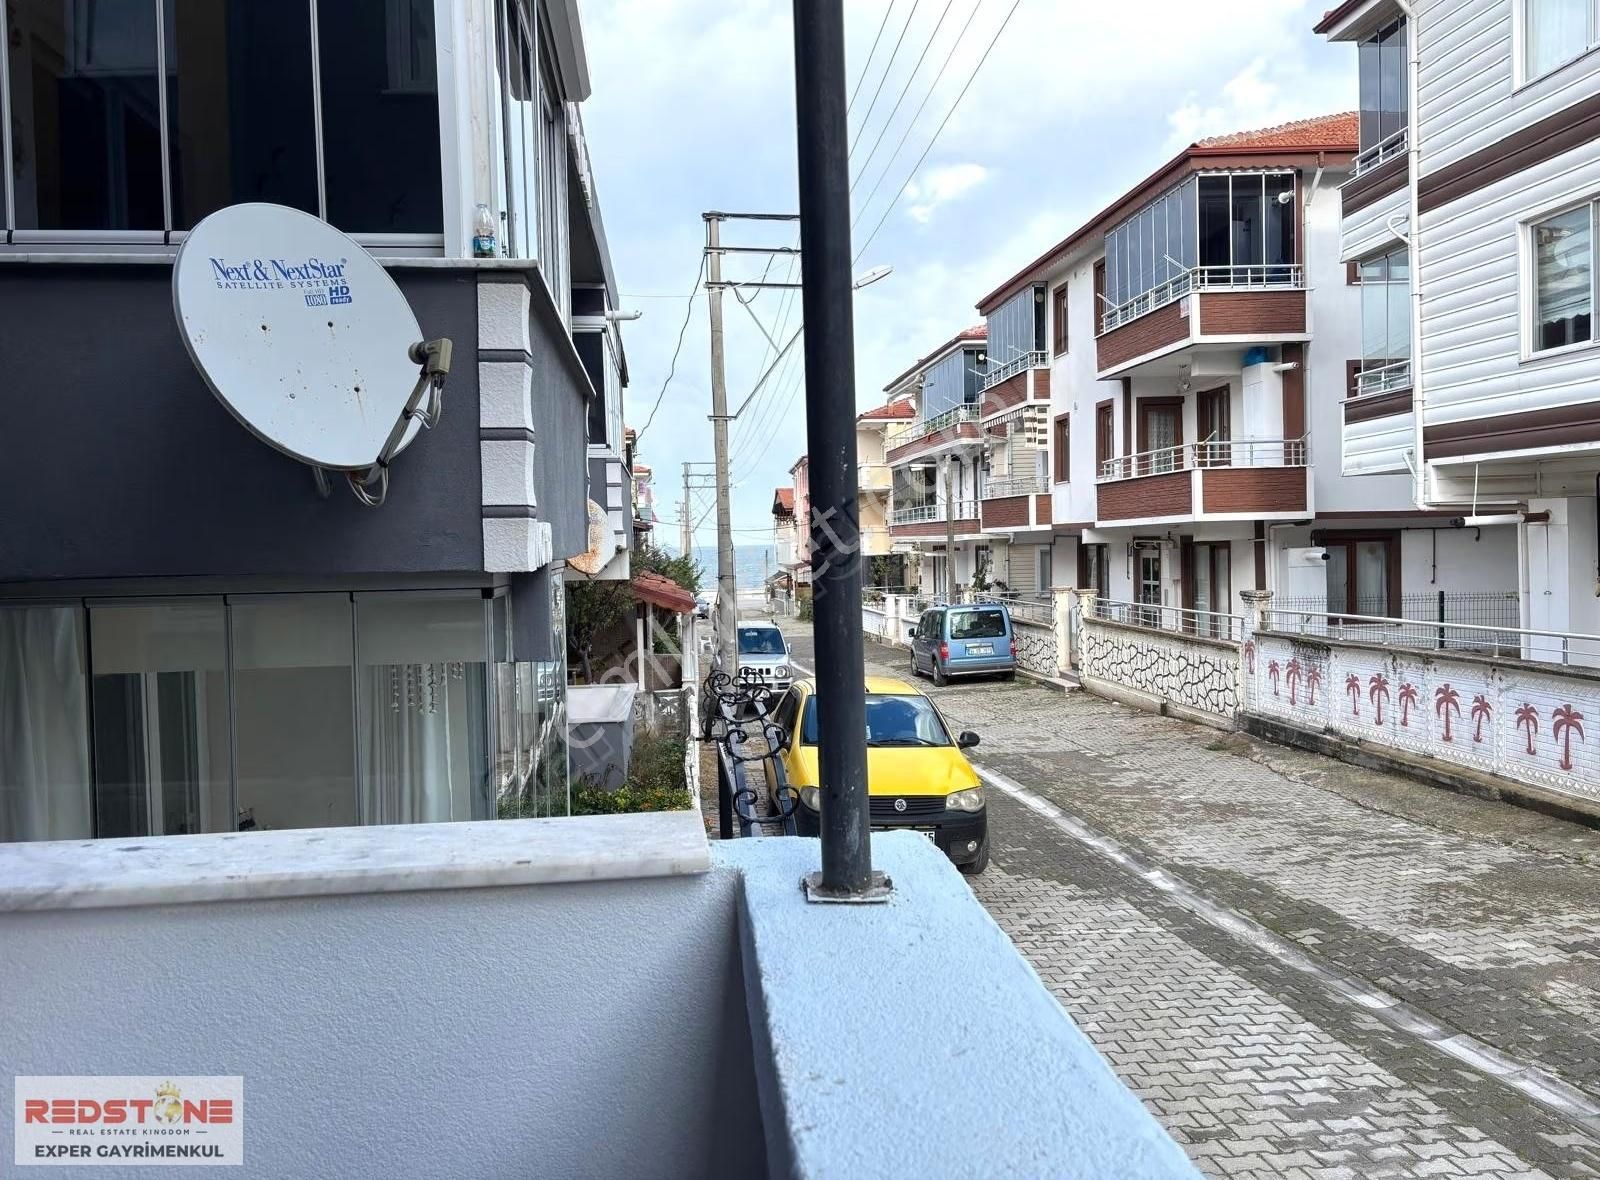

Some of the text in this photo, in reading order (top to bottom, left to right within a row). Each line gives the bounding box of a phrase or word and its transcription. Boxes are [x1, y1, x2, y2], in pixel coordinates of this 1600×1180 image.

[254, 258, 271, 281] &
[216, 278, 347, 289] SATELLITE SYSTEMS
[329, 285, 350, 297] HD
